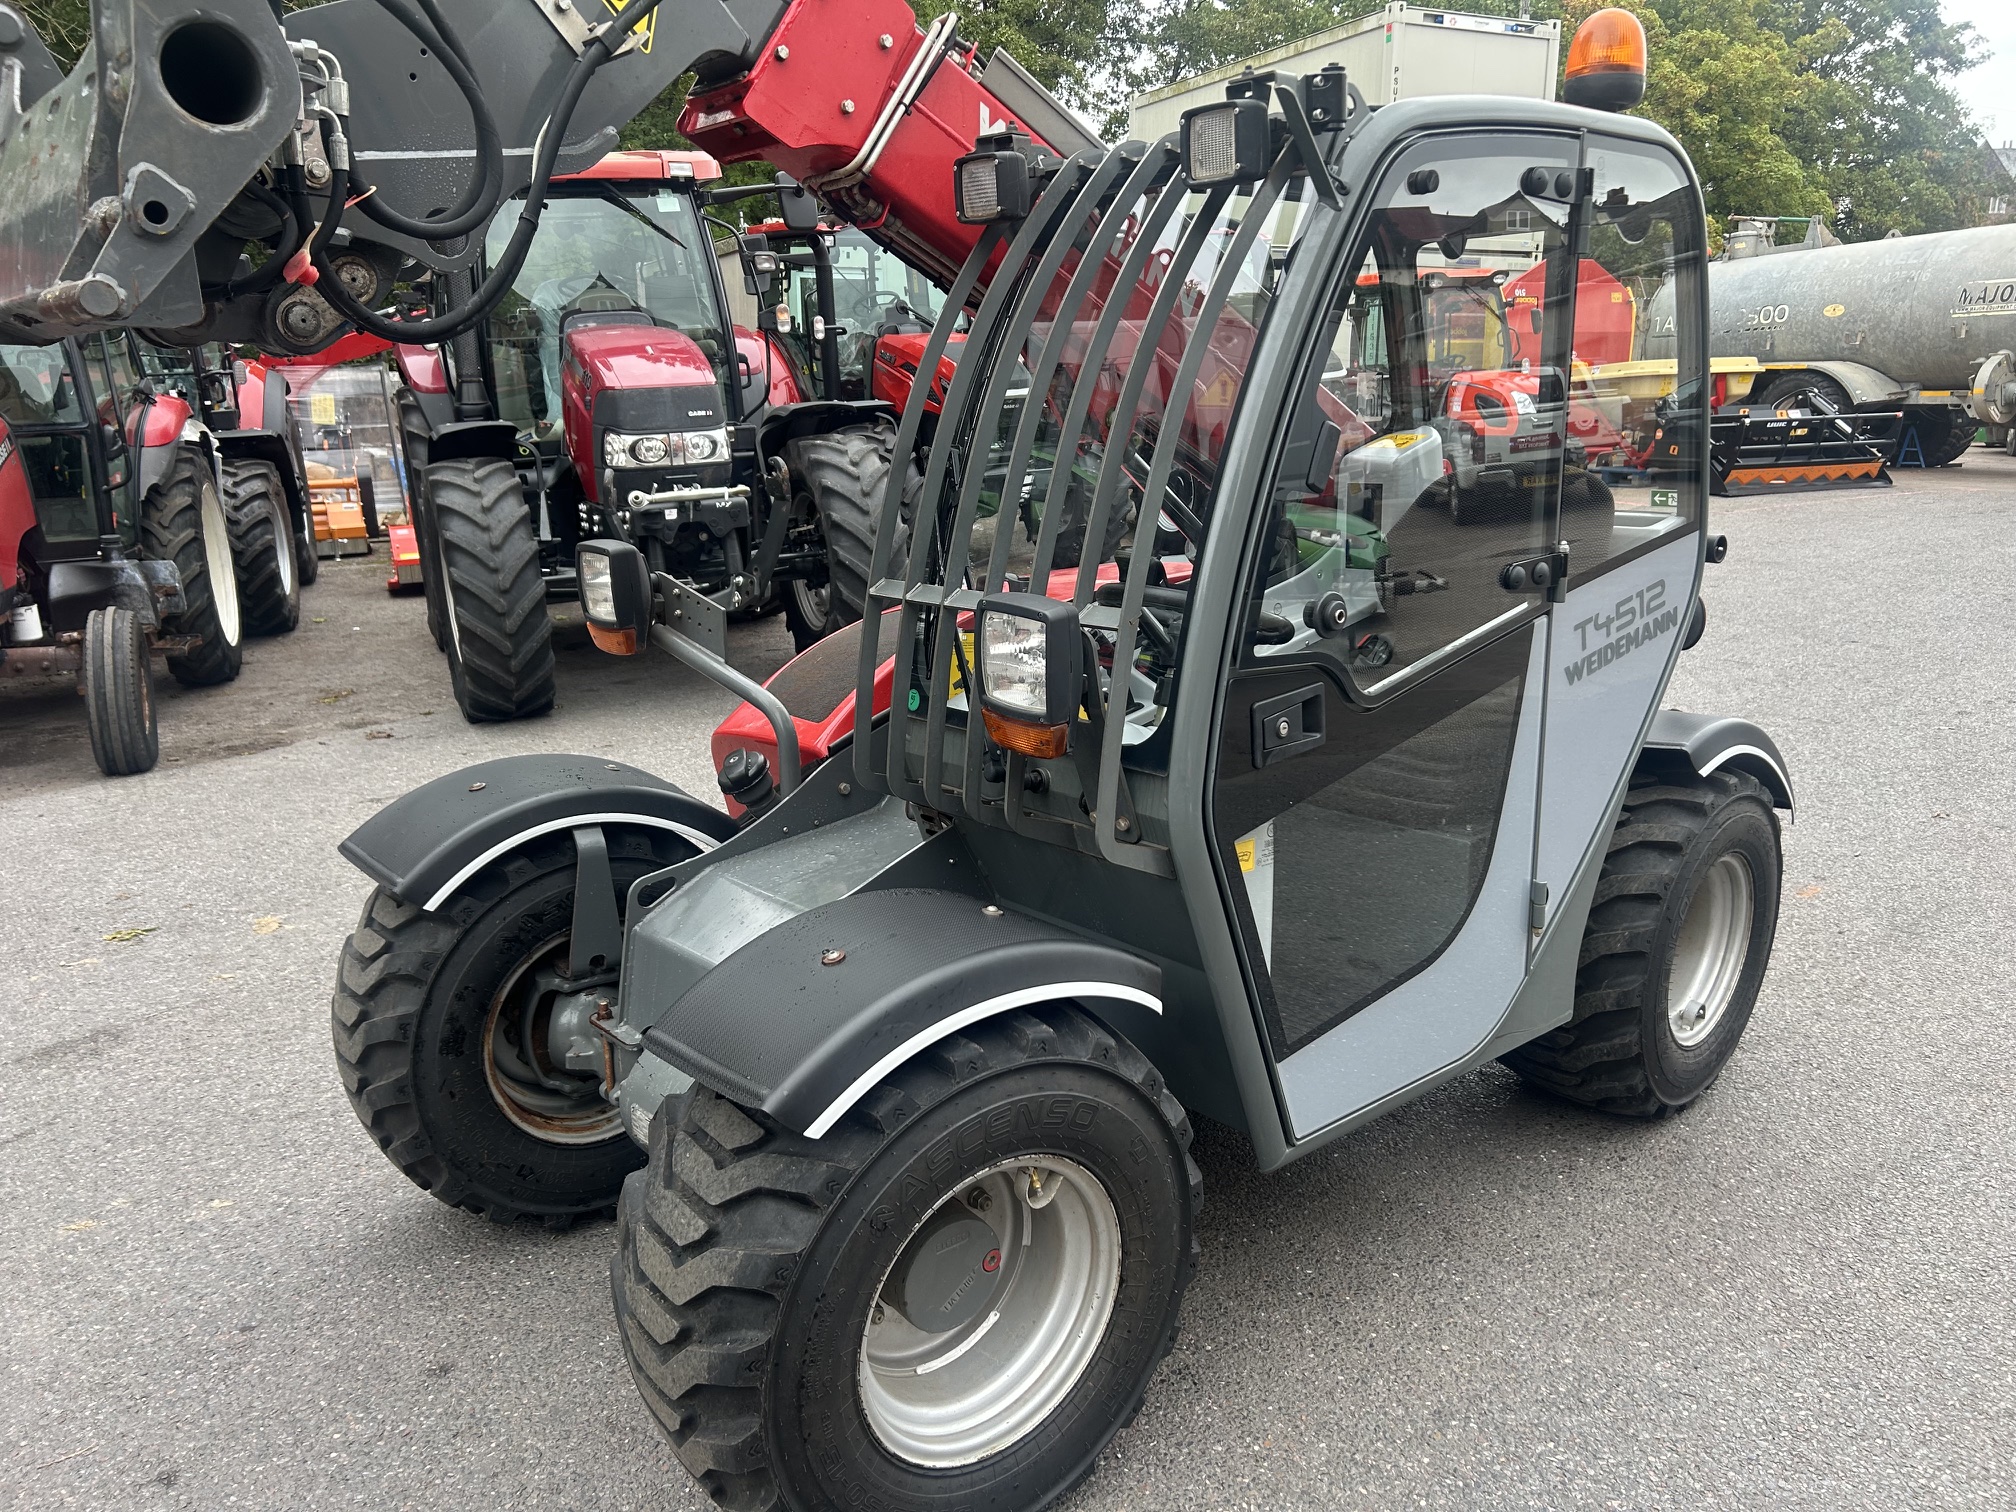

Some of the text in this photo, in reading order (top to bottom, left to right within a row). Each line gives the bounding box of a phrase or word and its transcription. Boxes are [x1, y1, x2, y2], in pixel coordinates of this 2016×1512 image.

[1958, 284, 2016, 305] MAJO
[1563, 605, 1678, 687] WEIDEMANN
[1573, 578, 1666, 652] T4512
[900, 1096, 1100, 1212] ASCENSO
